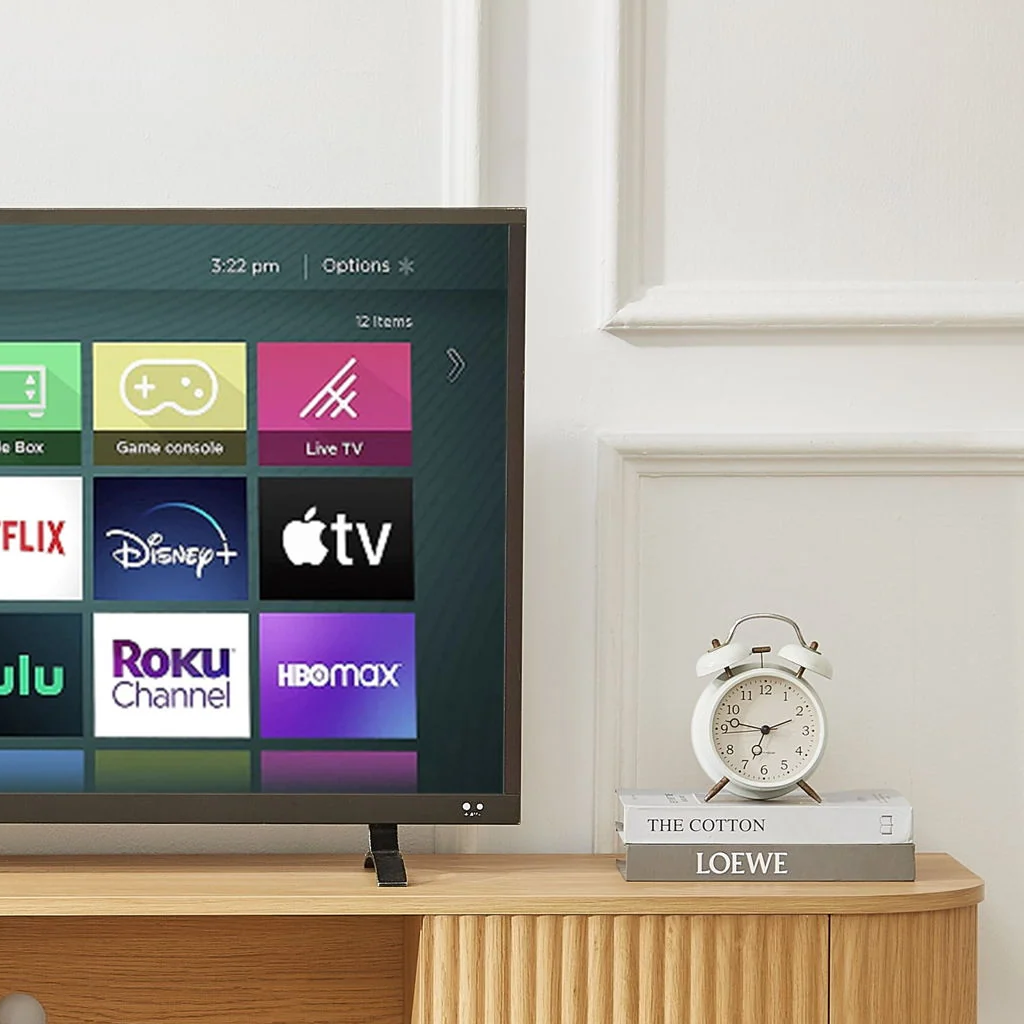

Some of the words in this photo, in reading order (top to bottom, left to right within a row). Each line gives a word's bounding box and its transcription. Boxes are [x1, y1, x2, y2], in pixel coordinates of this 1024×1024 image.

[210, 257, 247, 274] 3:22
[252, 259, 281, 277] pm
[322, 257, 391, 275] Options
[355, 315, 371, 329] 12
[372, 315, 414, 329] Items
[14, 439, 45, 455] Box
[116, 439, 162, 456] Game
[164, 439, 225, 456] console
[305, 440, 337, 457] Live
[340, 440, 365, 457] TV
[331, 513, 393, 567] tv
[112, 639, 230, 679] Roku
[112, 681, 231, 709] Channel
[740, 690, 752, 701] 11
[759, 684, 772, 695] 12
[783, 691, 788, 702] 1
[726, 704, 740, 715] 10
[795, 705, 804, 717] 2
[720, 723, 729, 735] 9
[801, 725, 810, 736] 3
[726, 744, 734, 755] 8
[795, 745, 803, 756] 4
[741, 759, 749, 770] 7
[760, 764, 769, 775] 6
[780, 759, 789, 770] 5
[647, 818, 684, 832] THE
[688, 818, 766, 832] COTTON
[696, 851, 788, 875] LOEWE
